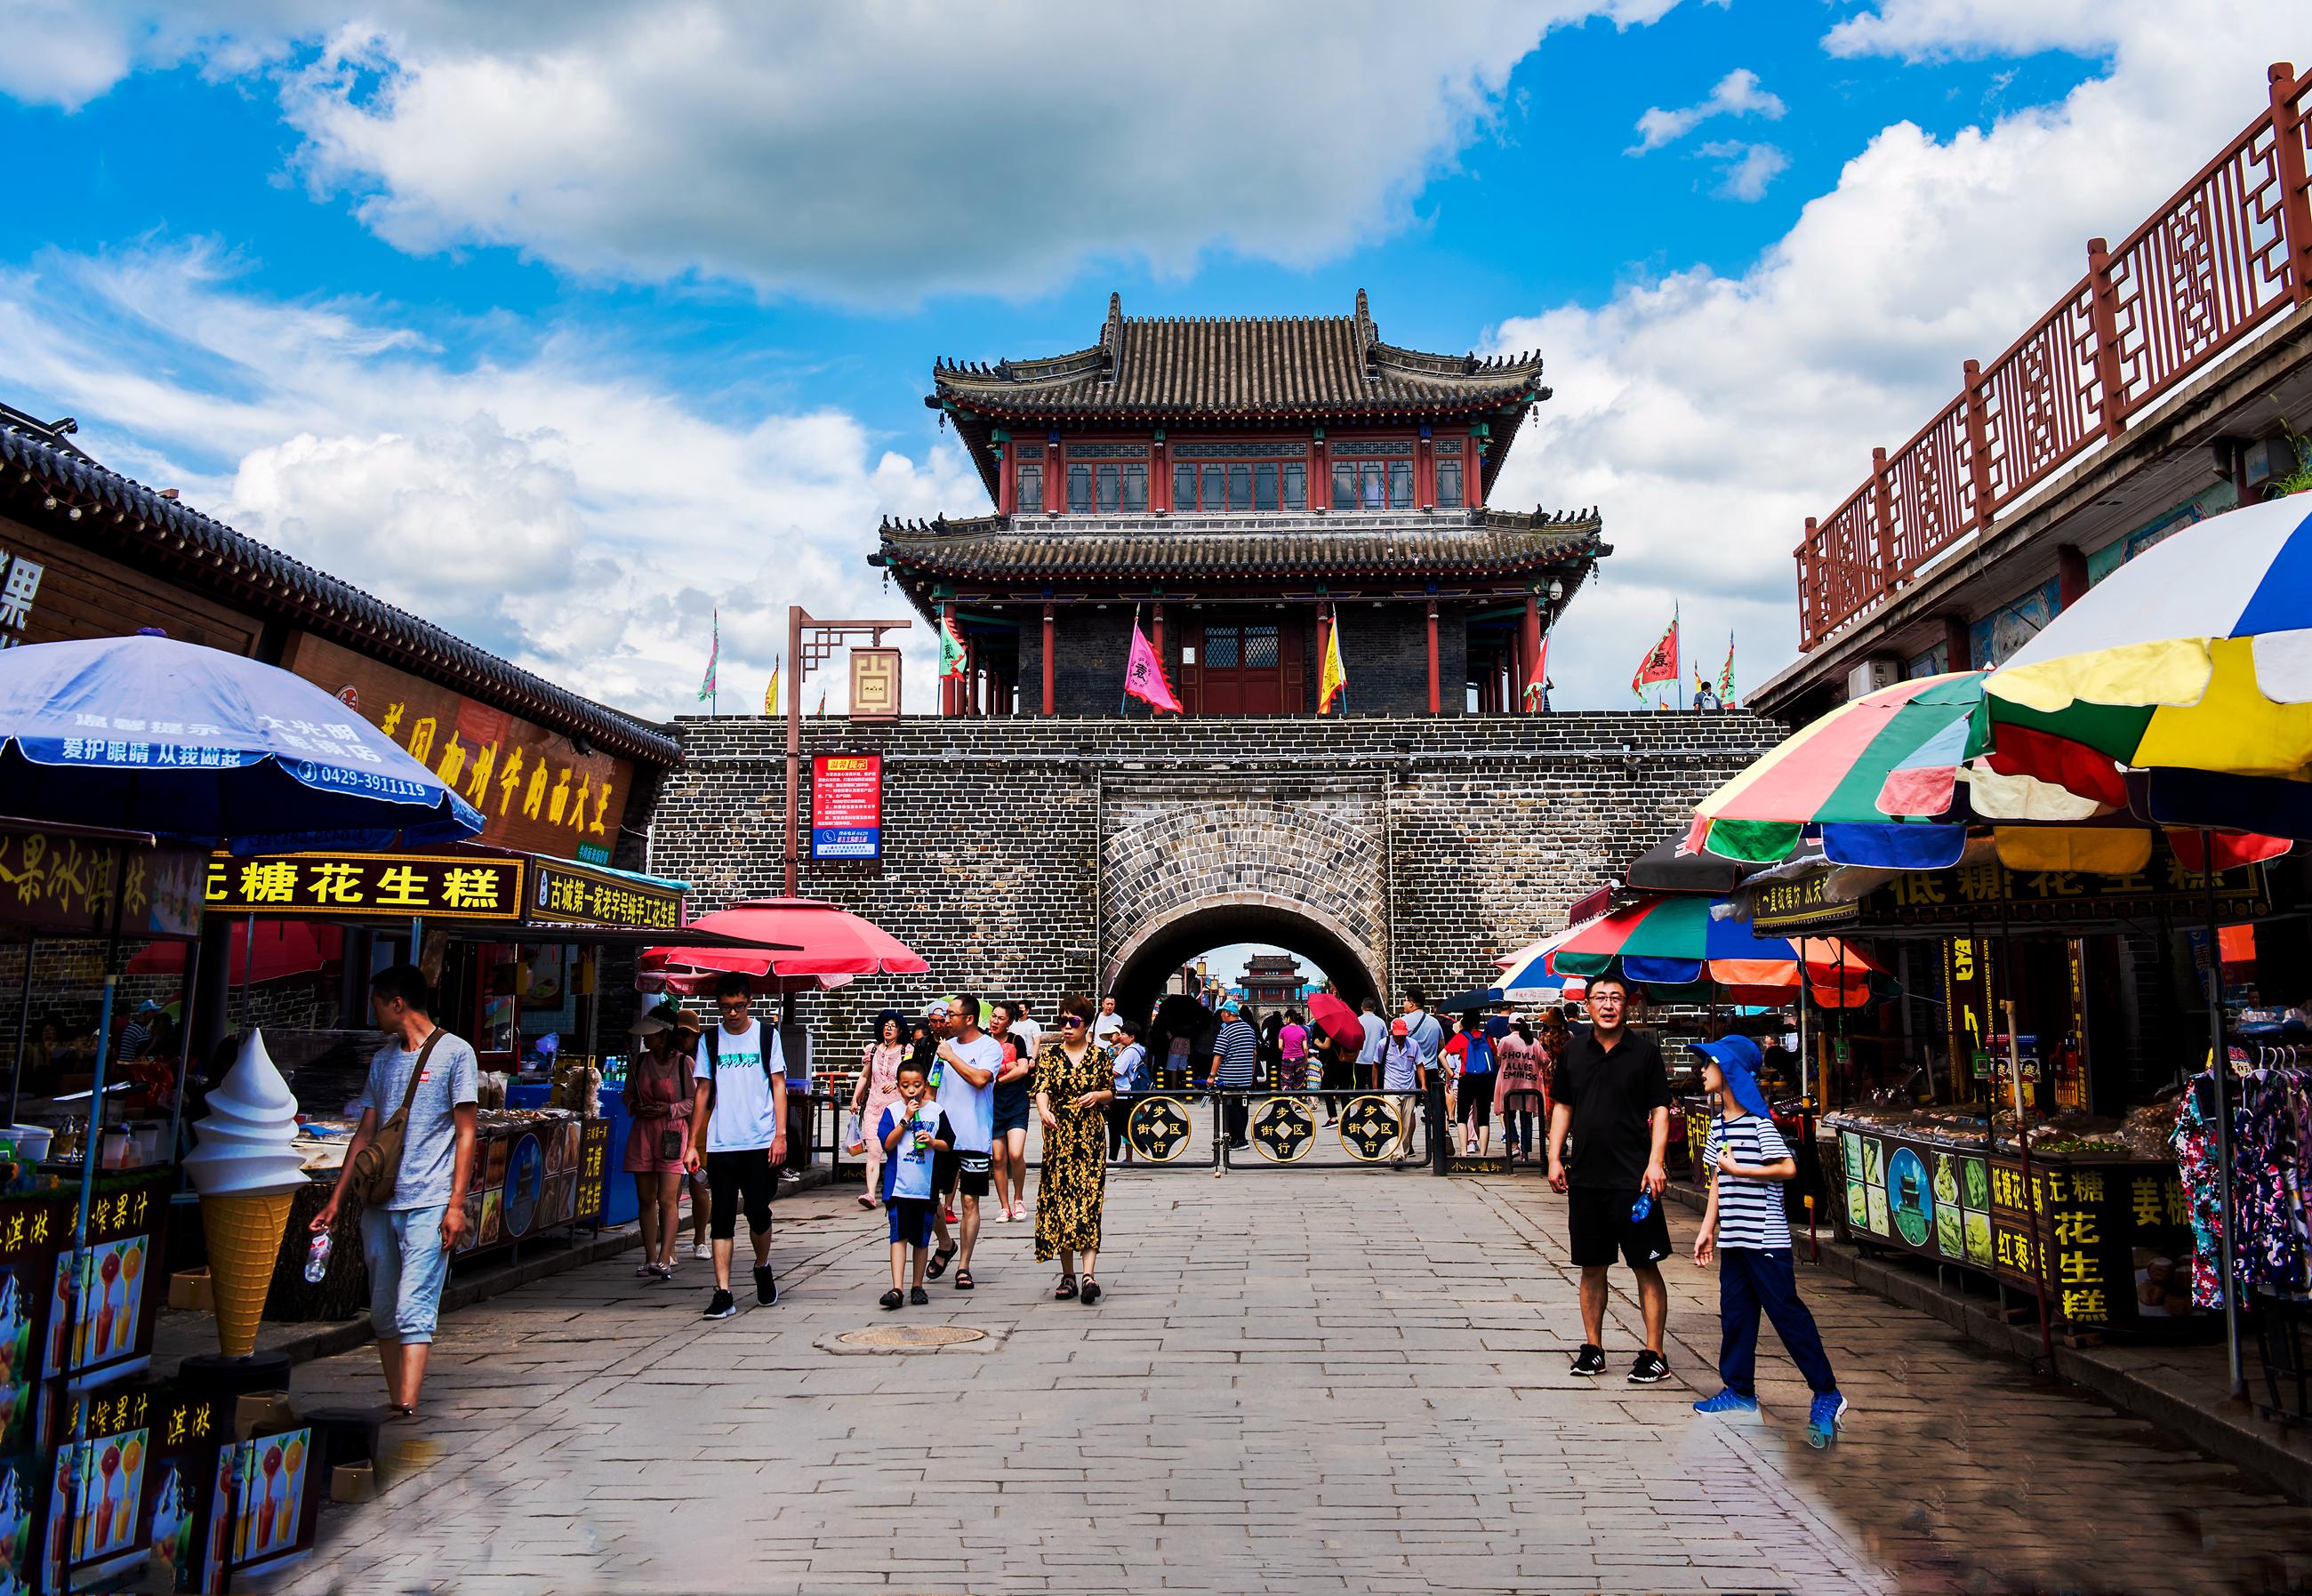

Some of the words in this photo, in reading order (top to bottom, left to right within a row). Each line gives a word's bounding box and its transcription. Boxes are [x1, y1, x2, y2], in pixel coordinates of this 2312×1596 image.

[0, 548, 44, 631] 果
[75, 713, 221, 736] 温馨提示
[62, 737, 150, 764] 爱护眼睛
[157, 742, 241, 767] 从我做起
[321, 766, 426, 797] 0429-3911119
[550, 875, 677, 927] 古城第一家老字号纯手工花生糕
[1505, 1063, 1522, 1071] ALL
[585, 1144, 603, 1177] 无糖
[577, 1180, 602, 1217] 花生糕
[1992, 1167, 2043, 1215] 低糖花酥
[2049, 1170, 2105, 1202] 无糖
[0, 1209, 48, 1253] 淇淋
